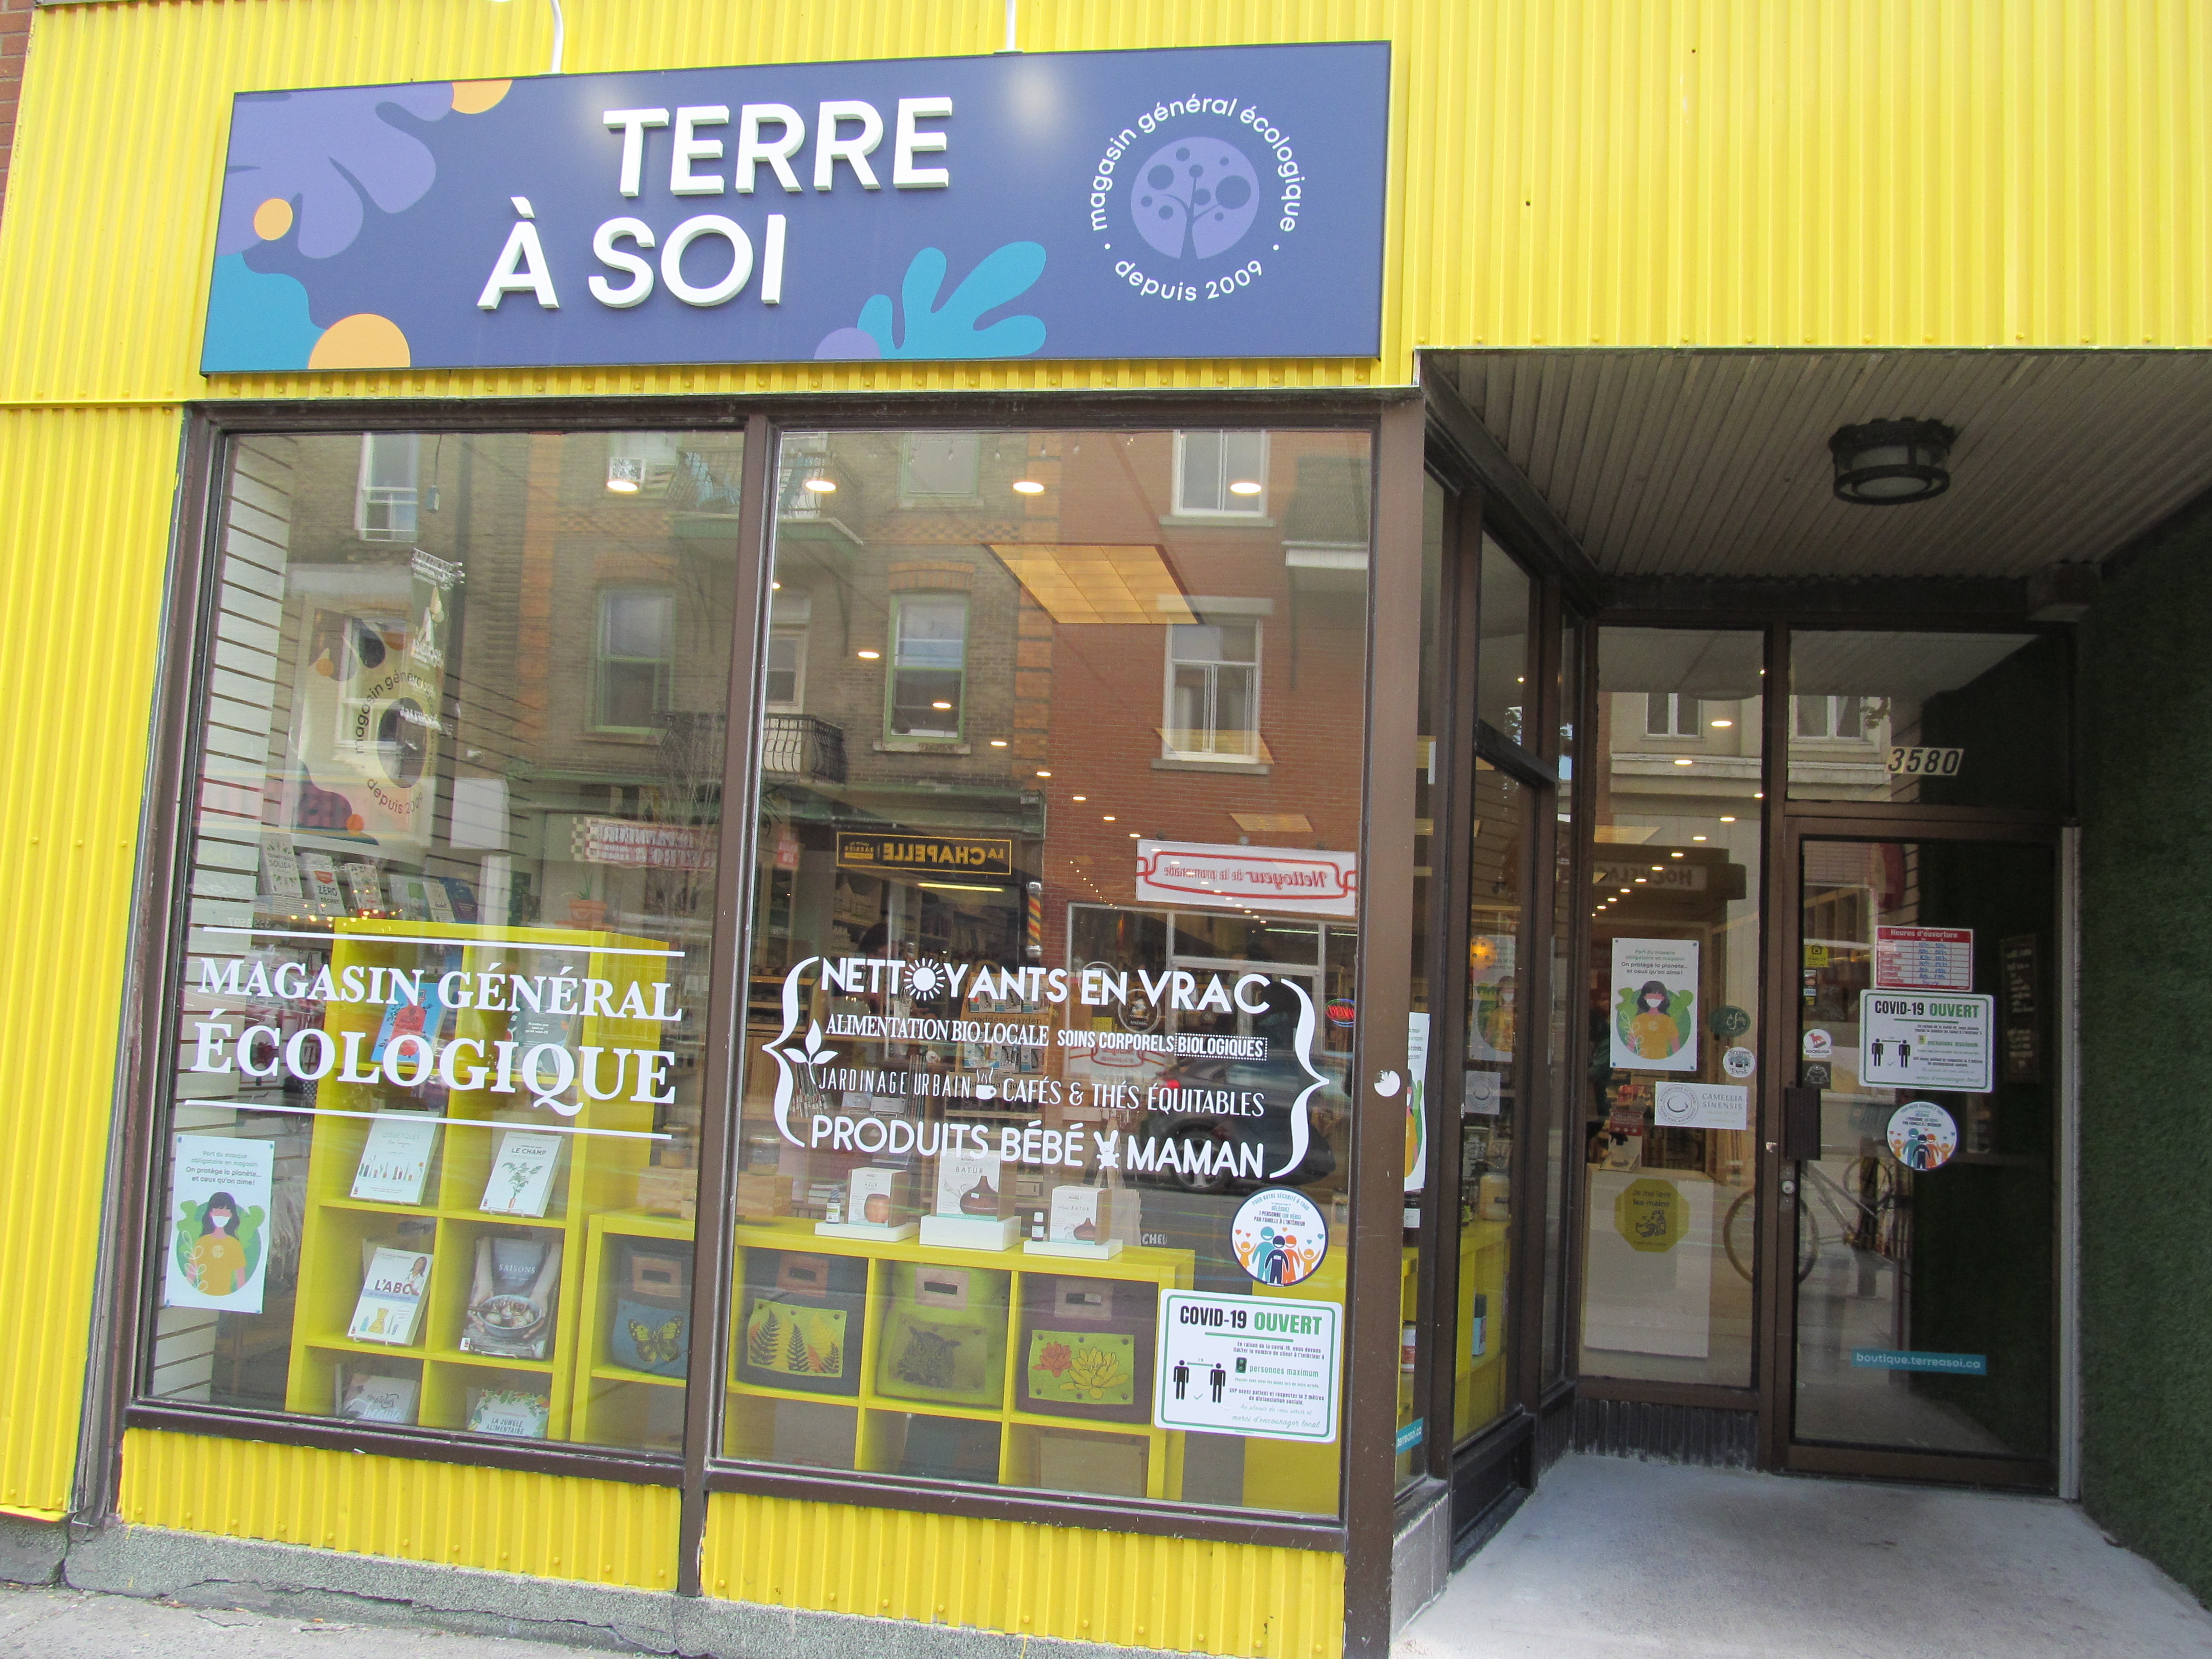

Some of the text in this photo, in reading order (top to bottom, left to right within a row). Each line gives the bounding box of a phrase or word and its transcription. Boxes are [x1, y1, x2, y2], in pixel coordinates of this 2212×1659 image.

[603, 96, 953, 197] TERRE
[1090, 94, 1305, 232] magasin général écologique
[477, 196, 787, 310] À SOI
[1115, 260, 1263, 302] depuis 2009
[1889, 748, 1960, 775] 3580
[367, 778, 403, 814] depuis
[317, 885, 337, 896] ZÉRO
[1917, 930, 1958, 938] d'ouverture
[198, 957, 683, 1023] MAGASIN GÉNÉRAL
[1080, 970, 1128, 1007] EN
[1137, 969, 1271, 1015] VRAC
[1875, 1000, 1980, 1018] COVID-19 OUVERT
[825, 1013, 951, 1040] ALIMENTATION
[984, 1023, 1049, 1047] LOCALE
[1057, 1029, 1096, 1047] SOINS
[1099, 1031, 1174, 1053] CORPORELS
[1177, 1037, 1264, 1058] BIOLOGIQUES
[190, 1008, 676, 1117] ÉCOLOGIQUE
[818, 1067, 1265, 1117] JARDINAGE URBAIN CAFÉS & THÉS ÉQUITABLES
[1702, 1093, 1743, 1101] CAMELLIA
[811, 1114, 1264, 1179] PRODUITS BÉBÉ MAMAN
[955, 1166, 984, 1174] BATUR
[1277, 1193, 1297, 1202] SÉCURITÉ
[1300, 1201, 1310, 1210] TOUS
[499, 1264, 536, 1273] SAISONS
[374, 1279, 412, 1294] L'ABC
[1180, 1305, 1323, 1335] COVID-19 OUVERT
[1250, 1365, 1284, 1375] personnes
[1286, 1368, 1318, 1377] maximum
[1856, 1352, 1981, 1369] boutique.terreasoi.ca
[485, 1423, 524, 1434] ALIMENTAIRE
[500, 1419, 523, 1427] JUNGLE
[1253, 1416, 1299, 1429] d'encourager
[1301, 1420, 1320, 1428] local
